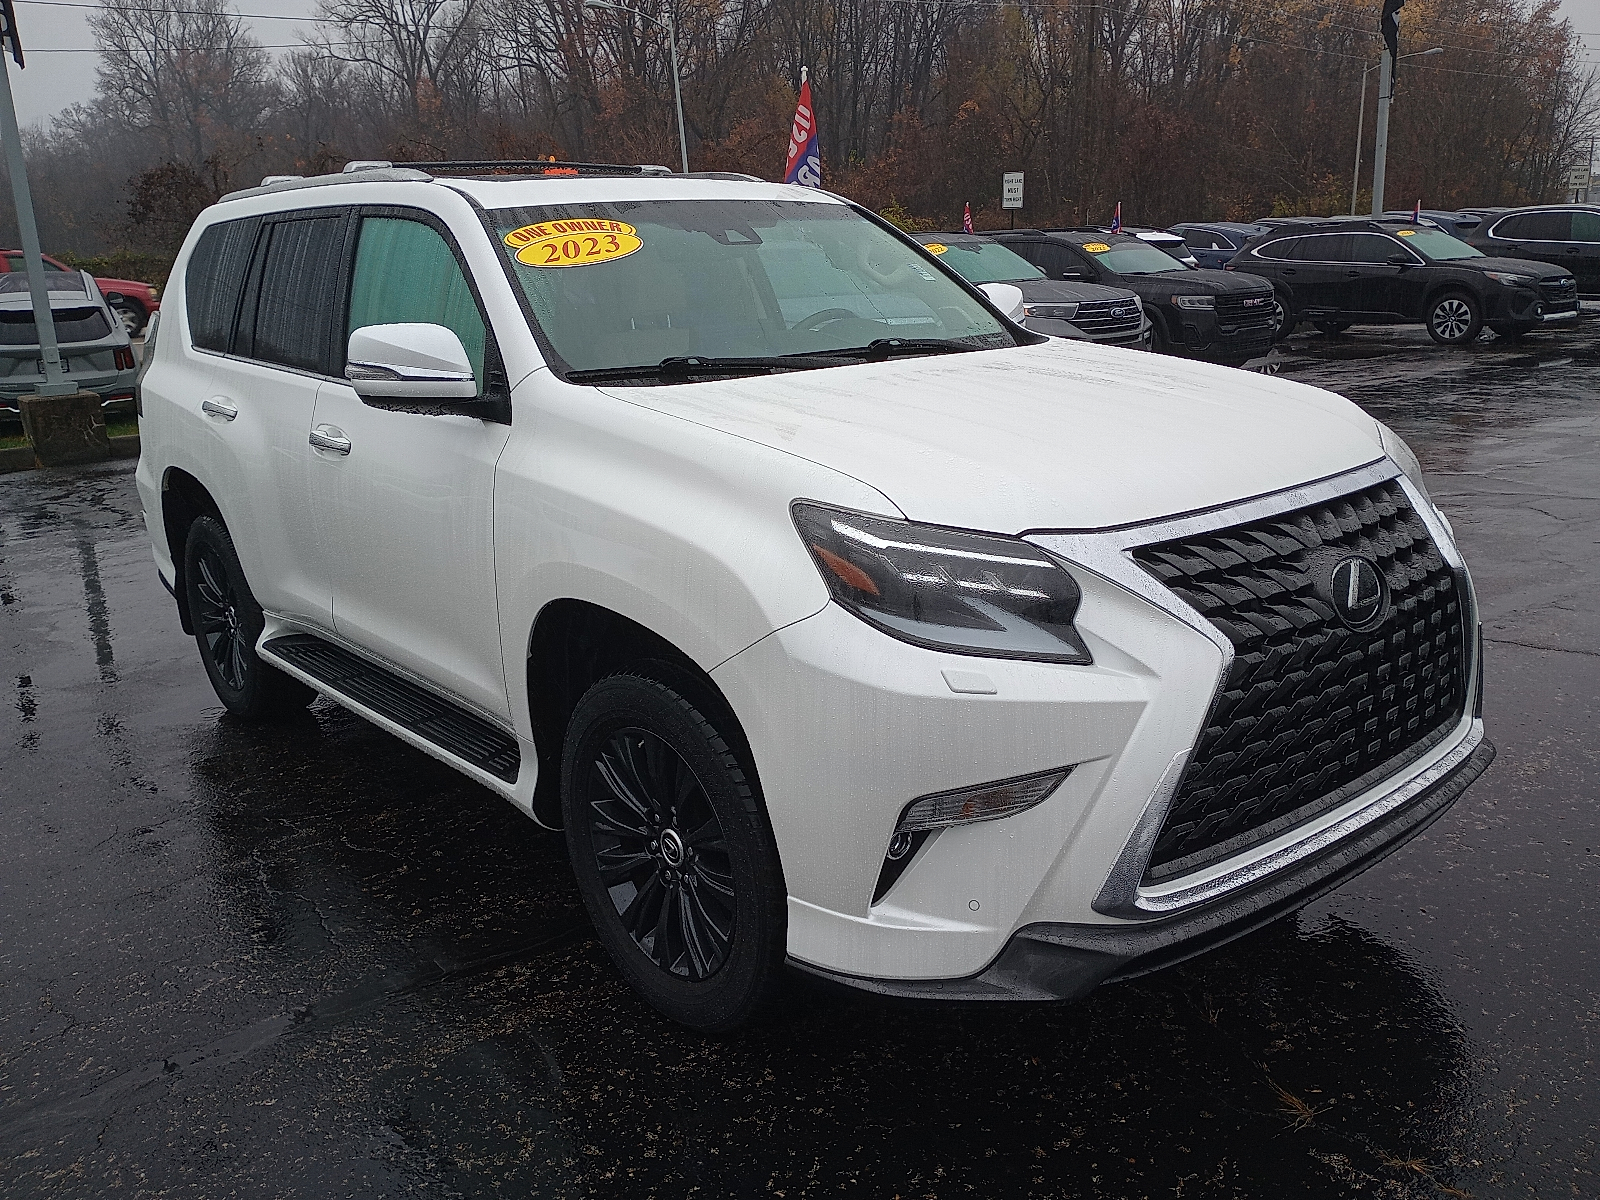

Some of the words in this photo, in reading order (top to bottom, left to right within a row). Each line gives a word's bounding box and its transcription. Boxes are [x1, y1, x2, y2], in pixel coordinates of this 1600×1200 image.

[512, 225, 552, 243] ONE
[552, 220, 622, 233] OWNER
[541, 234, 620, 264] 2023
